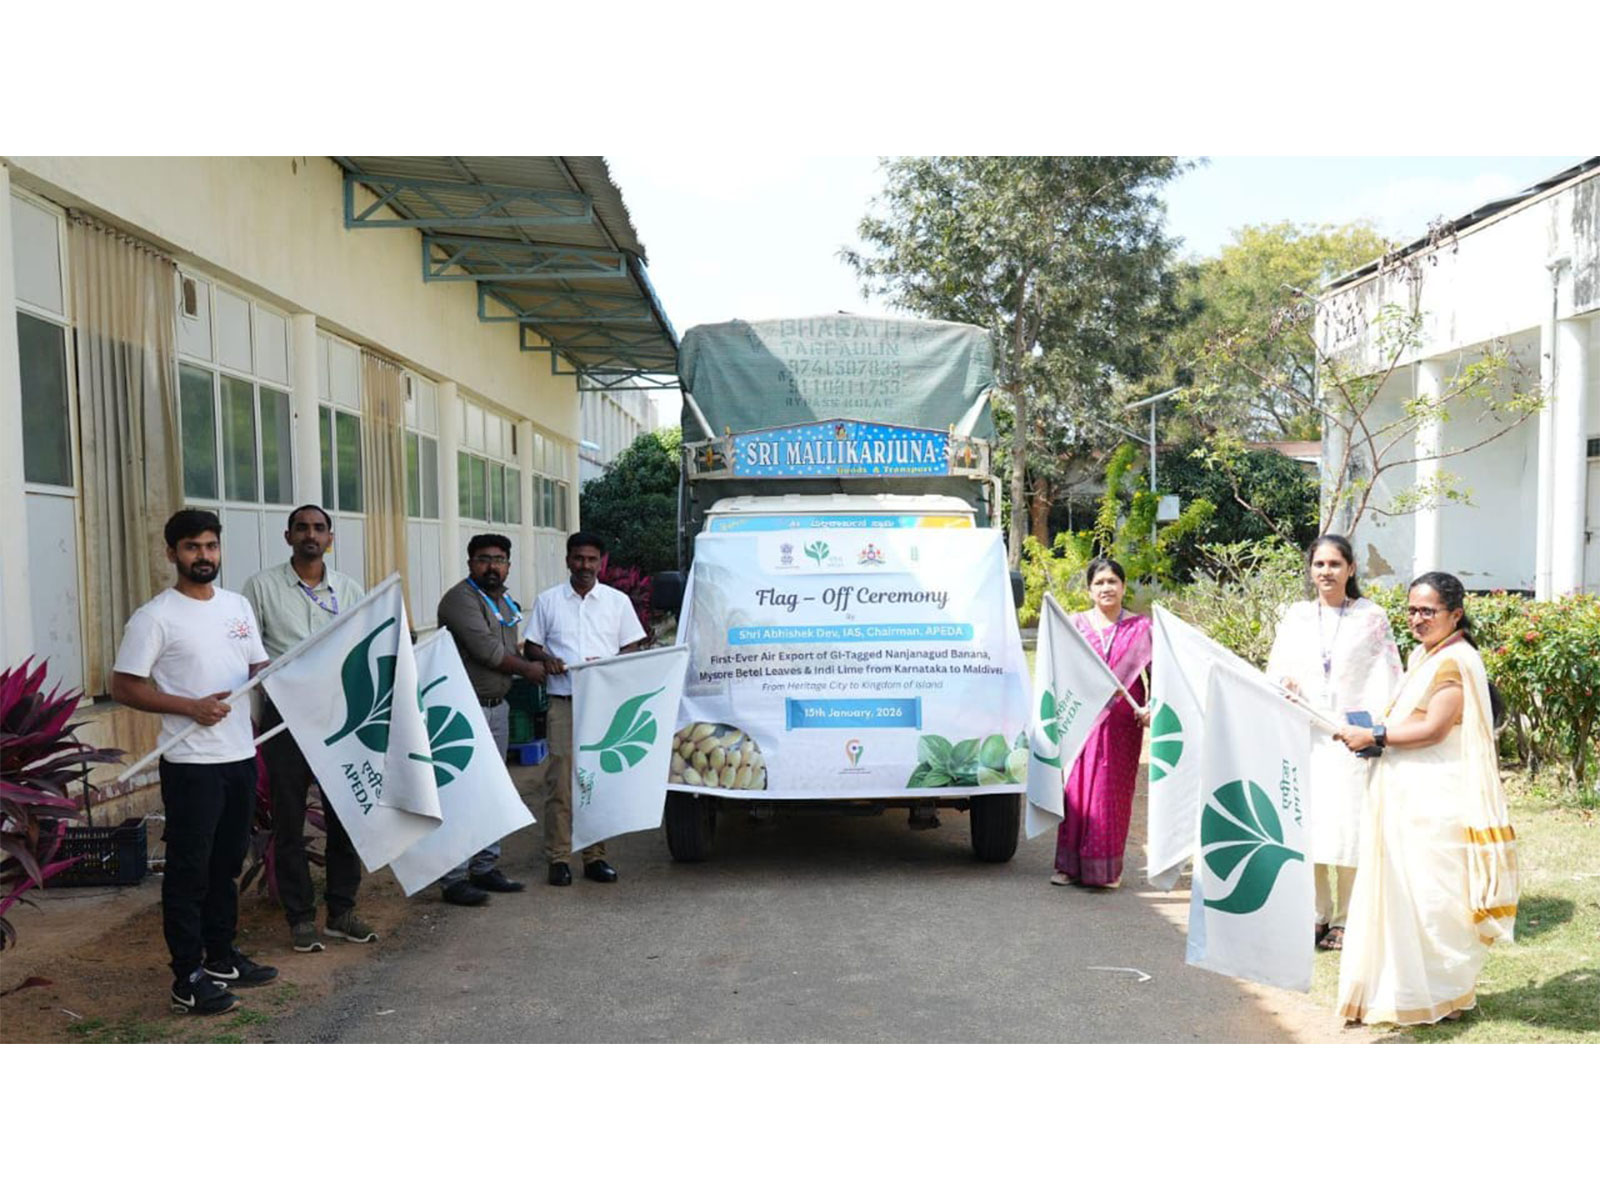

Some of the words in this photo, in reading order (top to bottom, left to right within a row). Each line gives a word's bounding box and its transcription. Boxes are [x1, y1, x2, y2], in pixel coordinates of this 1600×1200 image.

[780, 318, 901, 338] BHARATH
[780, 341, 900, 356] TARPAULIN
[747, 442, 779, 466] SRI
[786, 439, 937, 466] MALLIKARJUNA
[884, 466, 932, 475] Transport
[756, 588, 798, 613] Flag
[822, 586, 854, 612] Off
[856, 587, 950, 610] Ceremony
[739, 629, 762, 640] Shri
[763, 627, 814, 639] Abhishek
[816, 627, 840, 638] Dev,
[843, 627, 863, 638] IAS,
[925, 625, 964, 637] APEDA
[711, 652, 758, 665] First-Ever
[760, 651, 775, 661] Air
[779, 651, 814, 662] Export
[816, 650, 827, 660] of
[830, 650, 883, 662] GI-Tagged
[885, 649, 948, 660] Nanjanagud
[951, 649, 991, 661] Banana,
[699, 670, 733, 682] Mysore
[735, 667, 763, 679] Betel
[765, 666, 802, 677] Leaves
[804, 666, 812, 675] &
[814, 665, 834, 675] Indi
[837, 665, 863, 675] Lime
[866, 664, 892, 674] from
[894, 664, 948, 674] Karnataka
[950, 665, 961, 674] to
[762, 682, 785, 692] From
[787, 681, 827, 692] Heritage
[829, 680, 847, 691] City
[849, 681, 859, 689] to
[862, 680, 902, 691] Kingdom
[903, 680, 913, 689] of
[915, 680, 943, 689] Island
[804, 707, 825, 717] 15th
[828, 707, 873, 719] January,
[876, 707, 903, 717] 2026
[341, 763, 373, 815] APEDA
